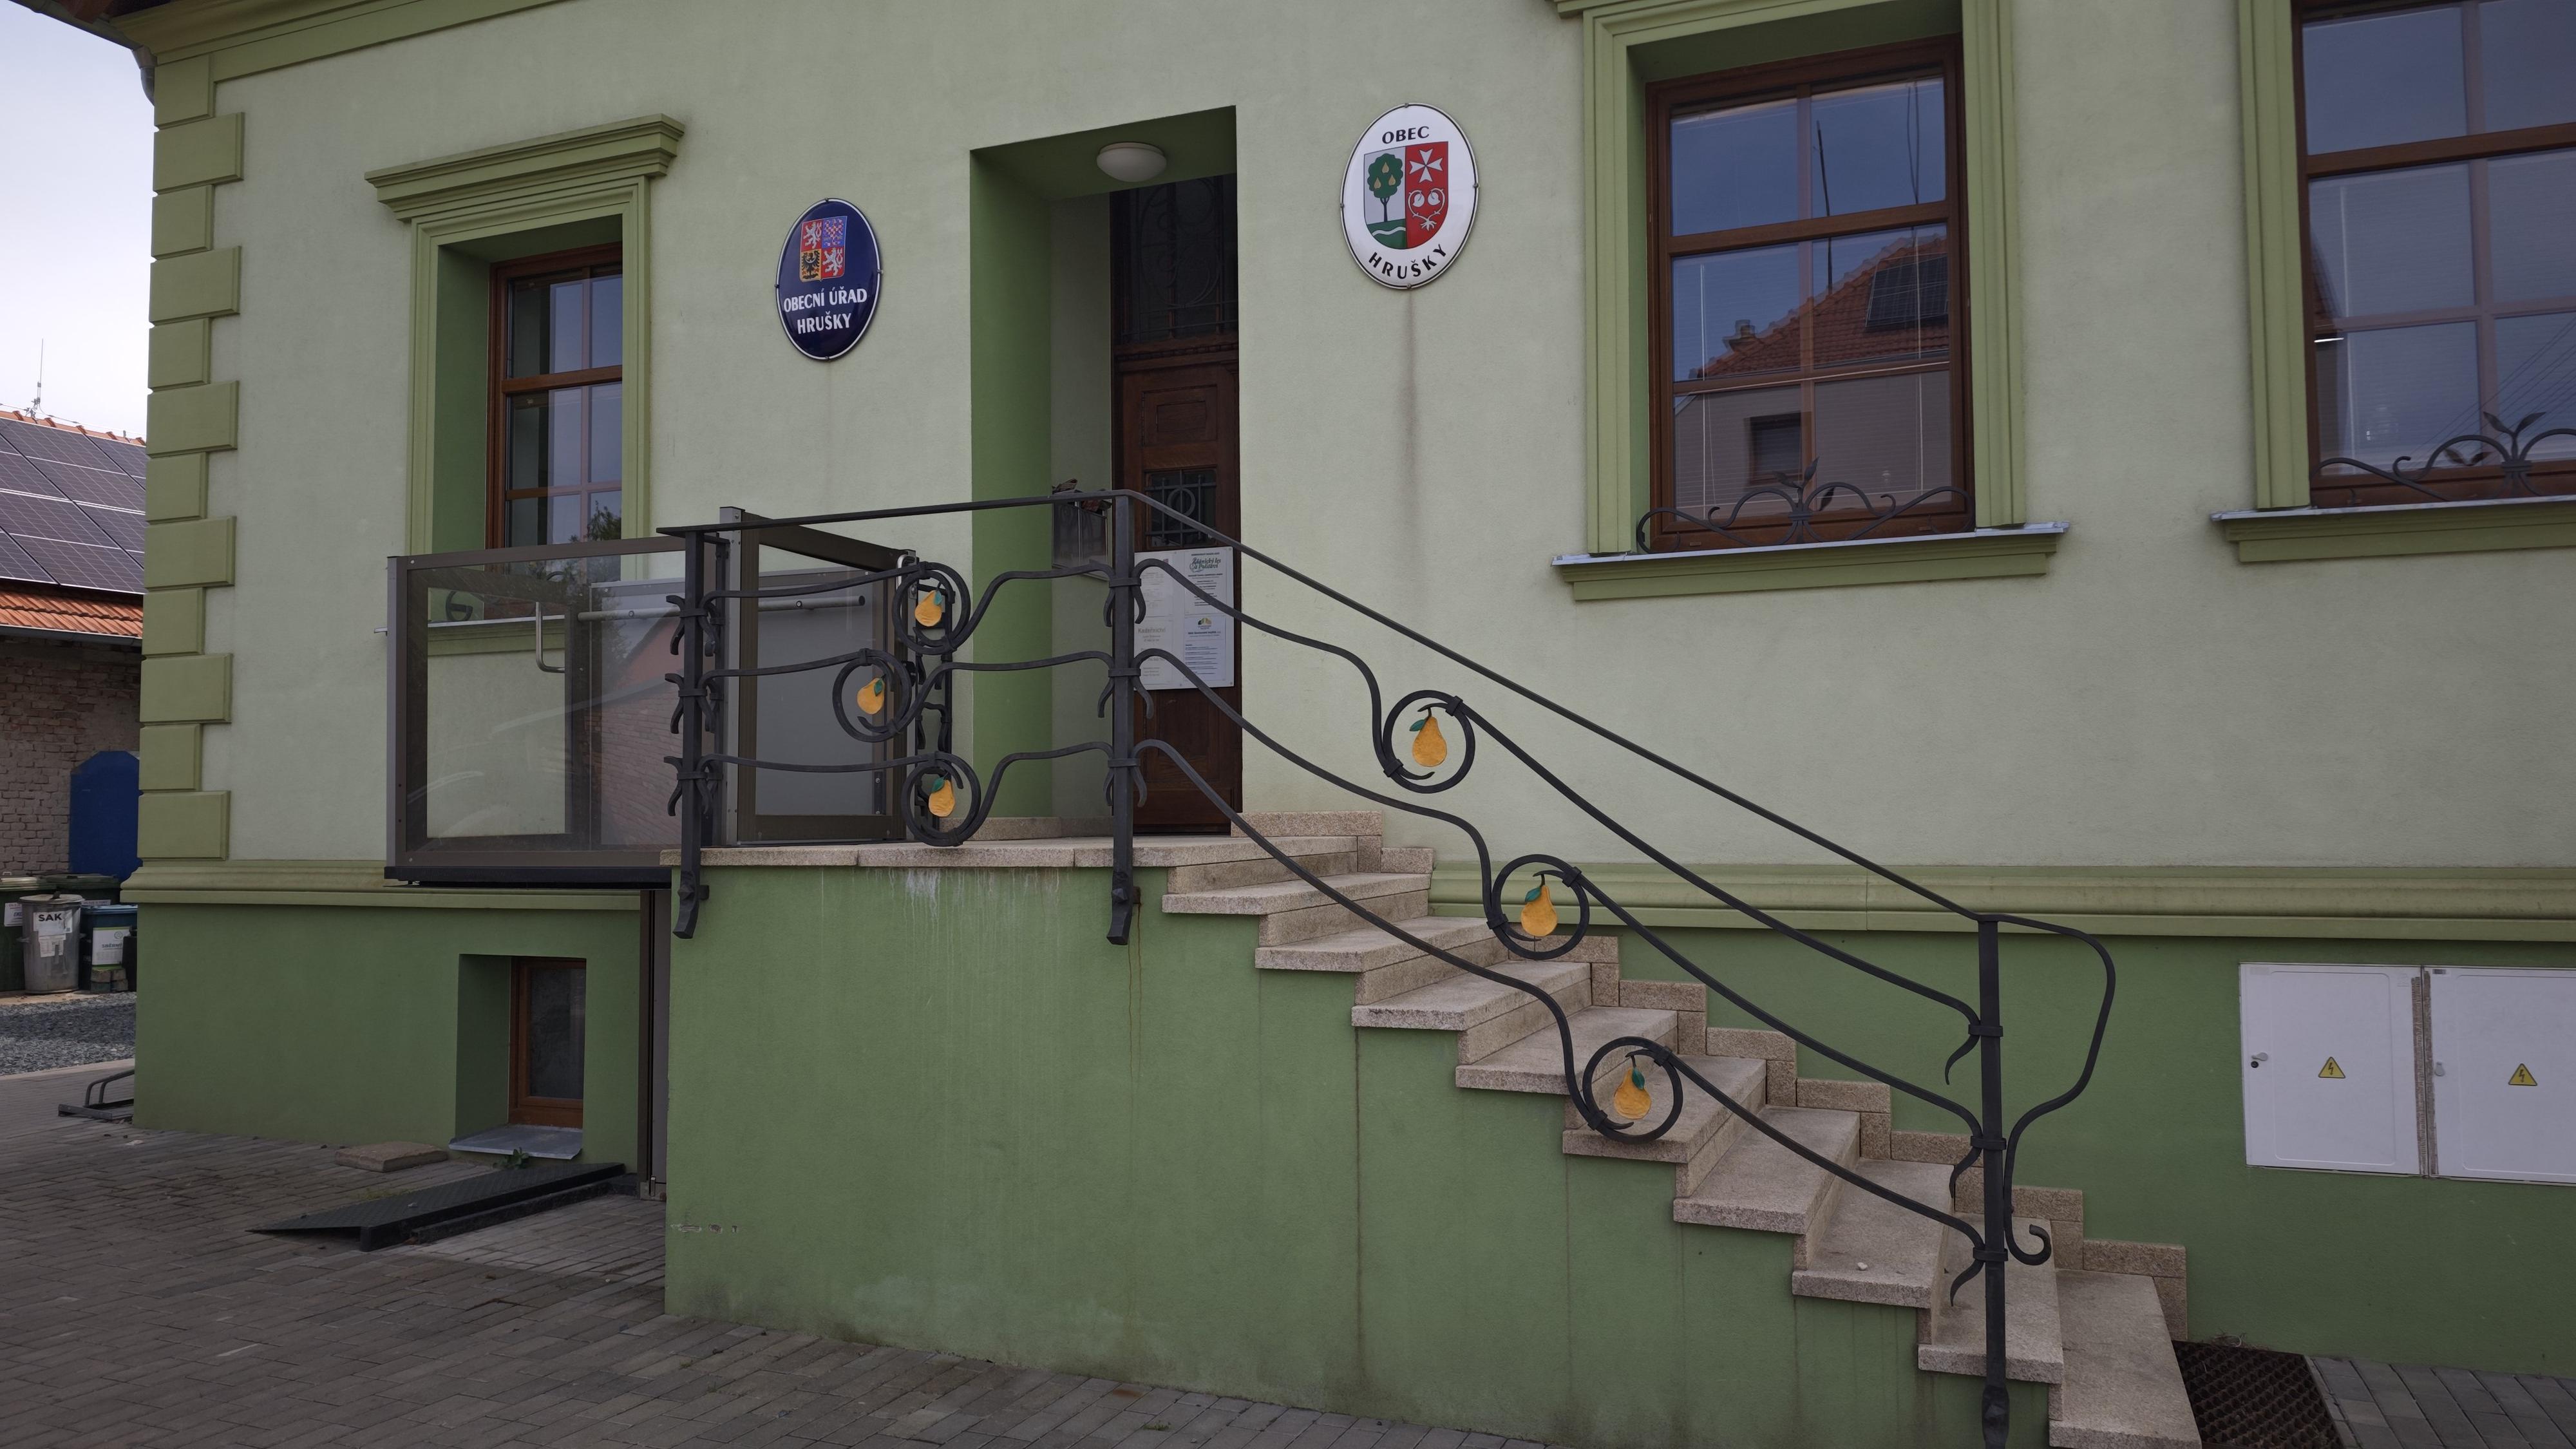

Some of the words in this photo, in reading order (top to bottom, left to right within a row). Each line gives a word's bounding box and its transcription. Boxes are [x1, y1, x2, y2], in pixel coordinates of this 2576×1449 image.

[1382, 126, 1430, 144] OBEC
[1368, 244, 1447, 279] HRUŠKY
[784, 288, 825, 312] OBECNÍ
[829, 286, 867, 306] ÚŘAD
[797, 311, 852, 334] HRUŠKY
[39, 913, 62, 922] SAK
